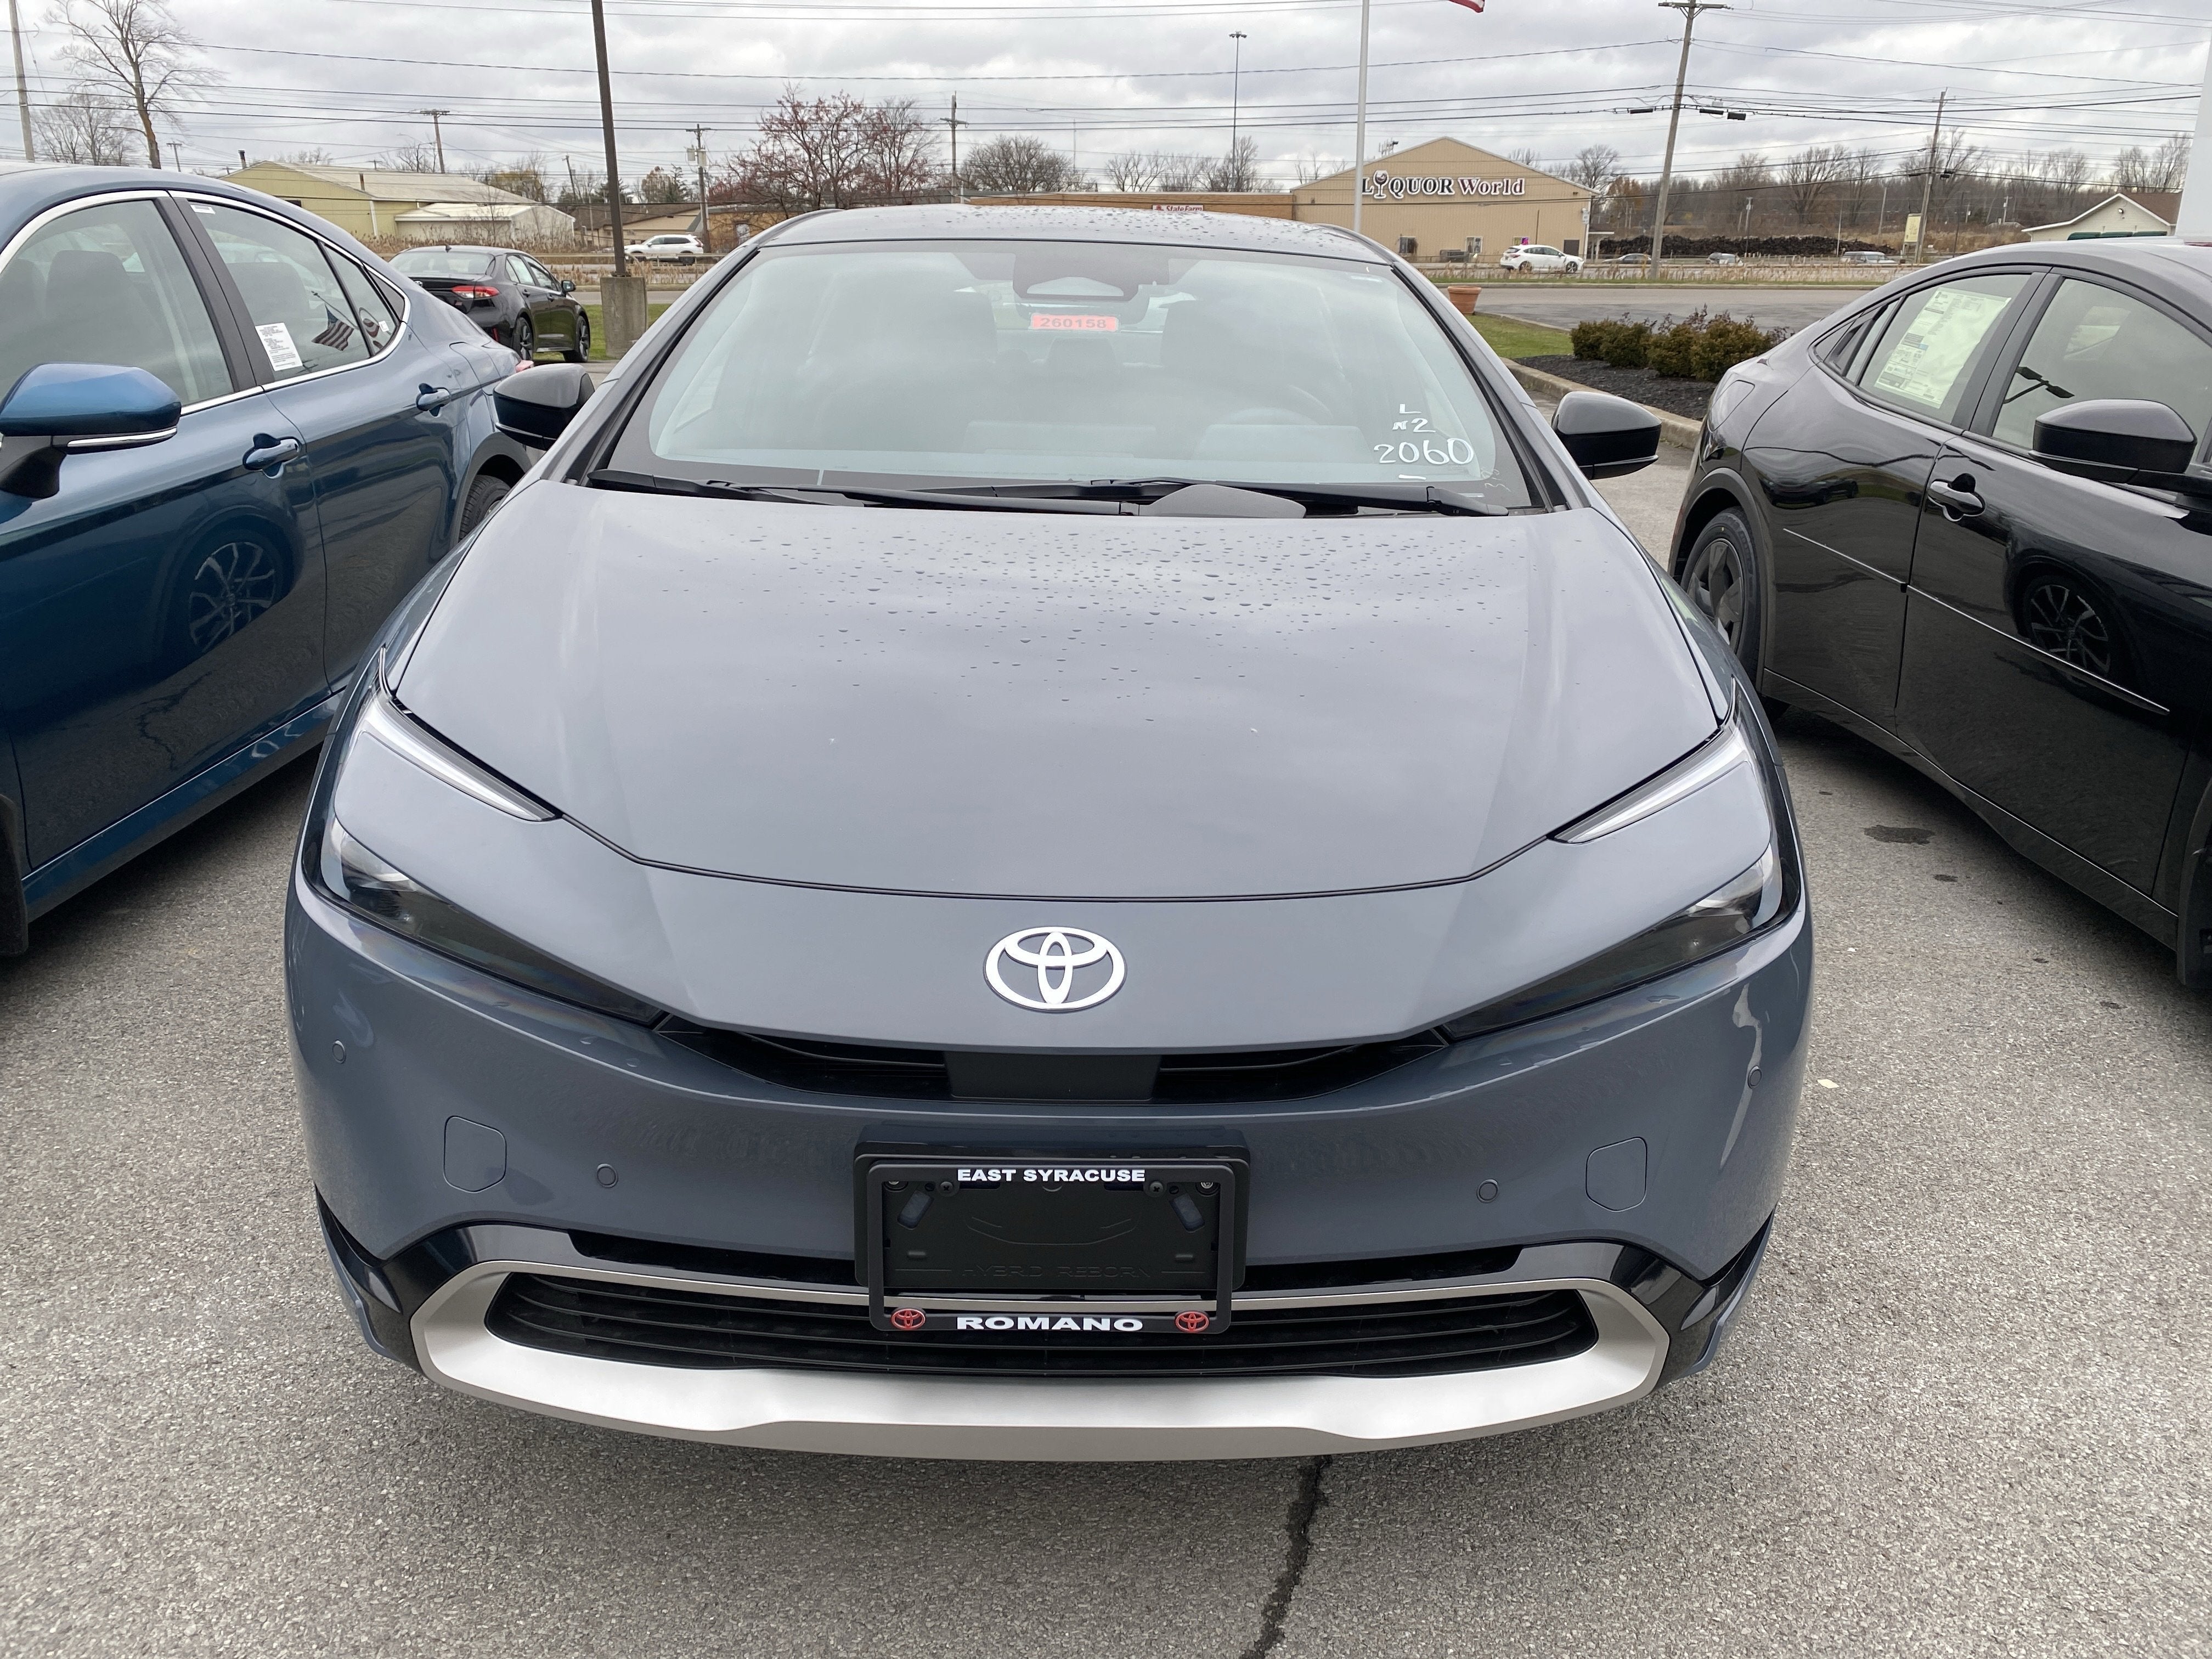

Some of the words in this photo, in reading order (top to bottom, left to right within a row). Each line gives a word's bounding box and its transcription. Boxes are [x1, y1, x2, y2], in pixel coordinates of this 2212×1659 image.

[1458, 177, 1525, 195] World
[1040, 318, 1107, 329] 260158
[1400, 403, 1422, 414] L
[1374, 438, 1474, 465] 2060
[957, 1169, 1016, 1181] EAST
[1023, 1169, 1146, 1182] SYRACUSE
[962, 1265, 1043, 1277] HYBRD
[957, 1317, 1143, 1331] ROMANO
